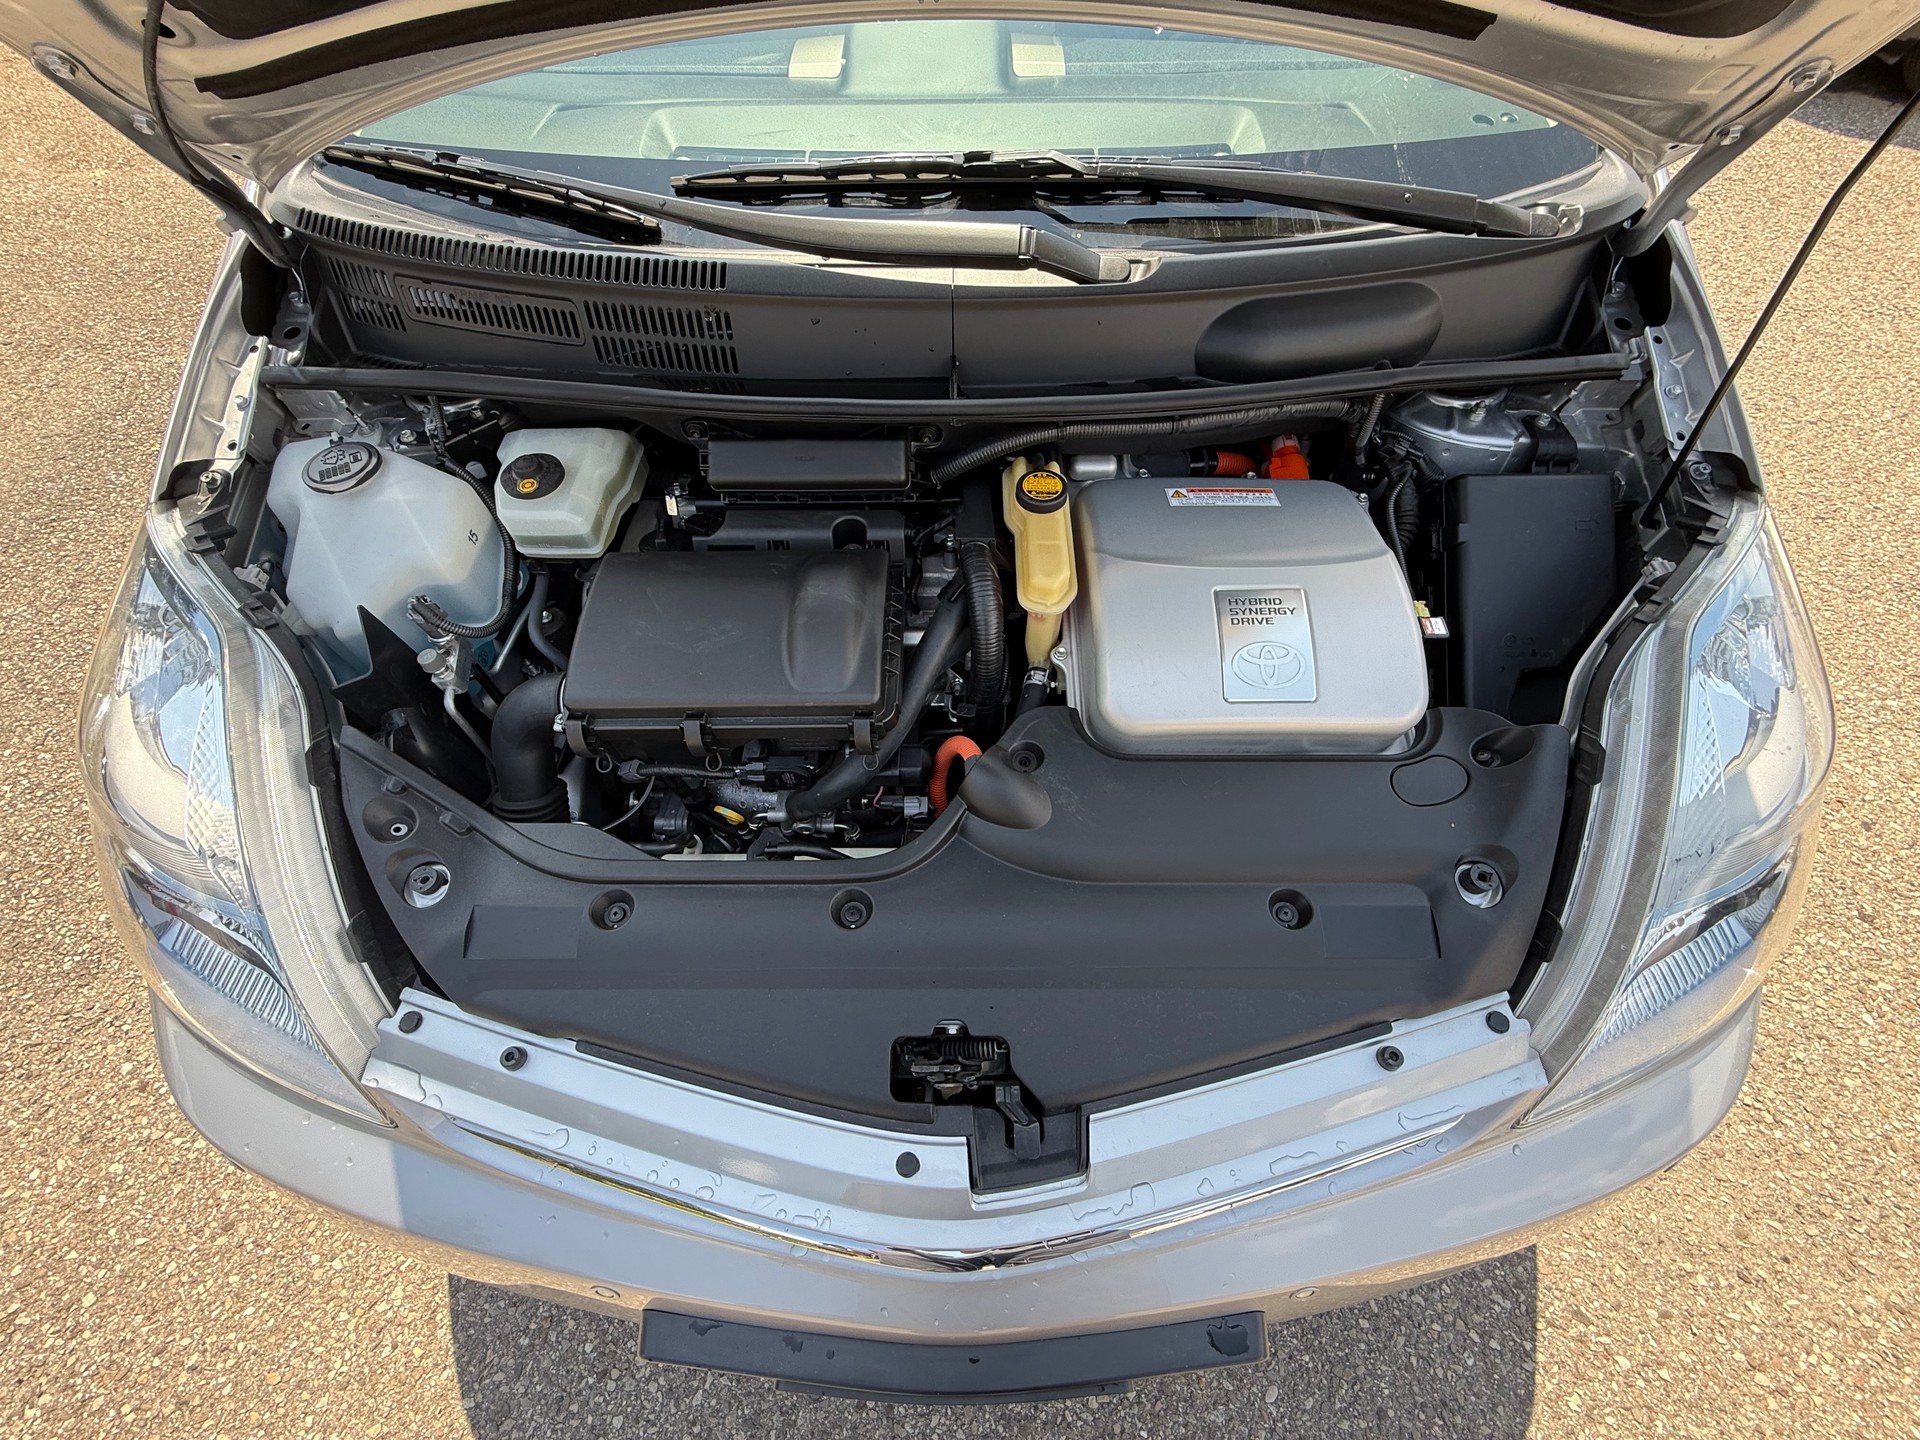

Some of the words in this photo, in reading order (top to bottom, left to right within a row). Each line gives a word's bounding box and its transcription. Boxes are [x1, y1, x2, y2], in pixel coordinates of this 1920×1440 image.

[467, 529, 479, 546] 15
[1228, 597, 1282, 605] HYBRID
[1229, 607, 1296, 616] SYNERGY
[1230, 617, 1274, 625] DRIVE
